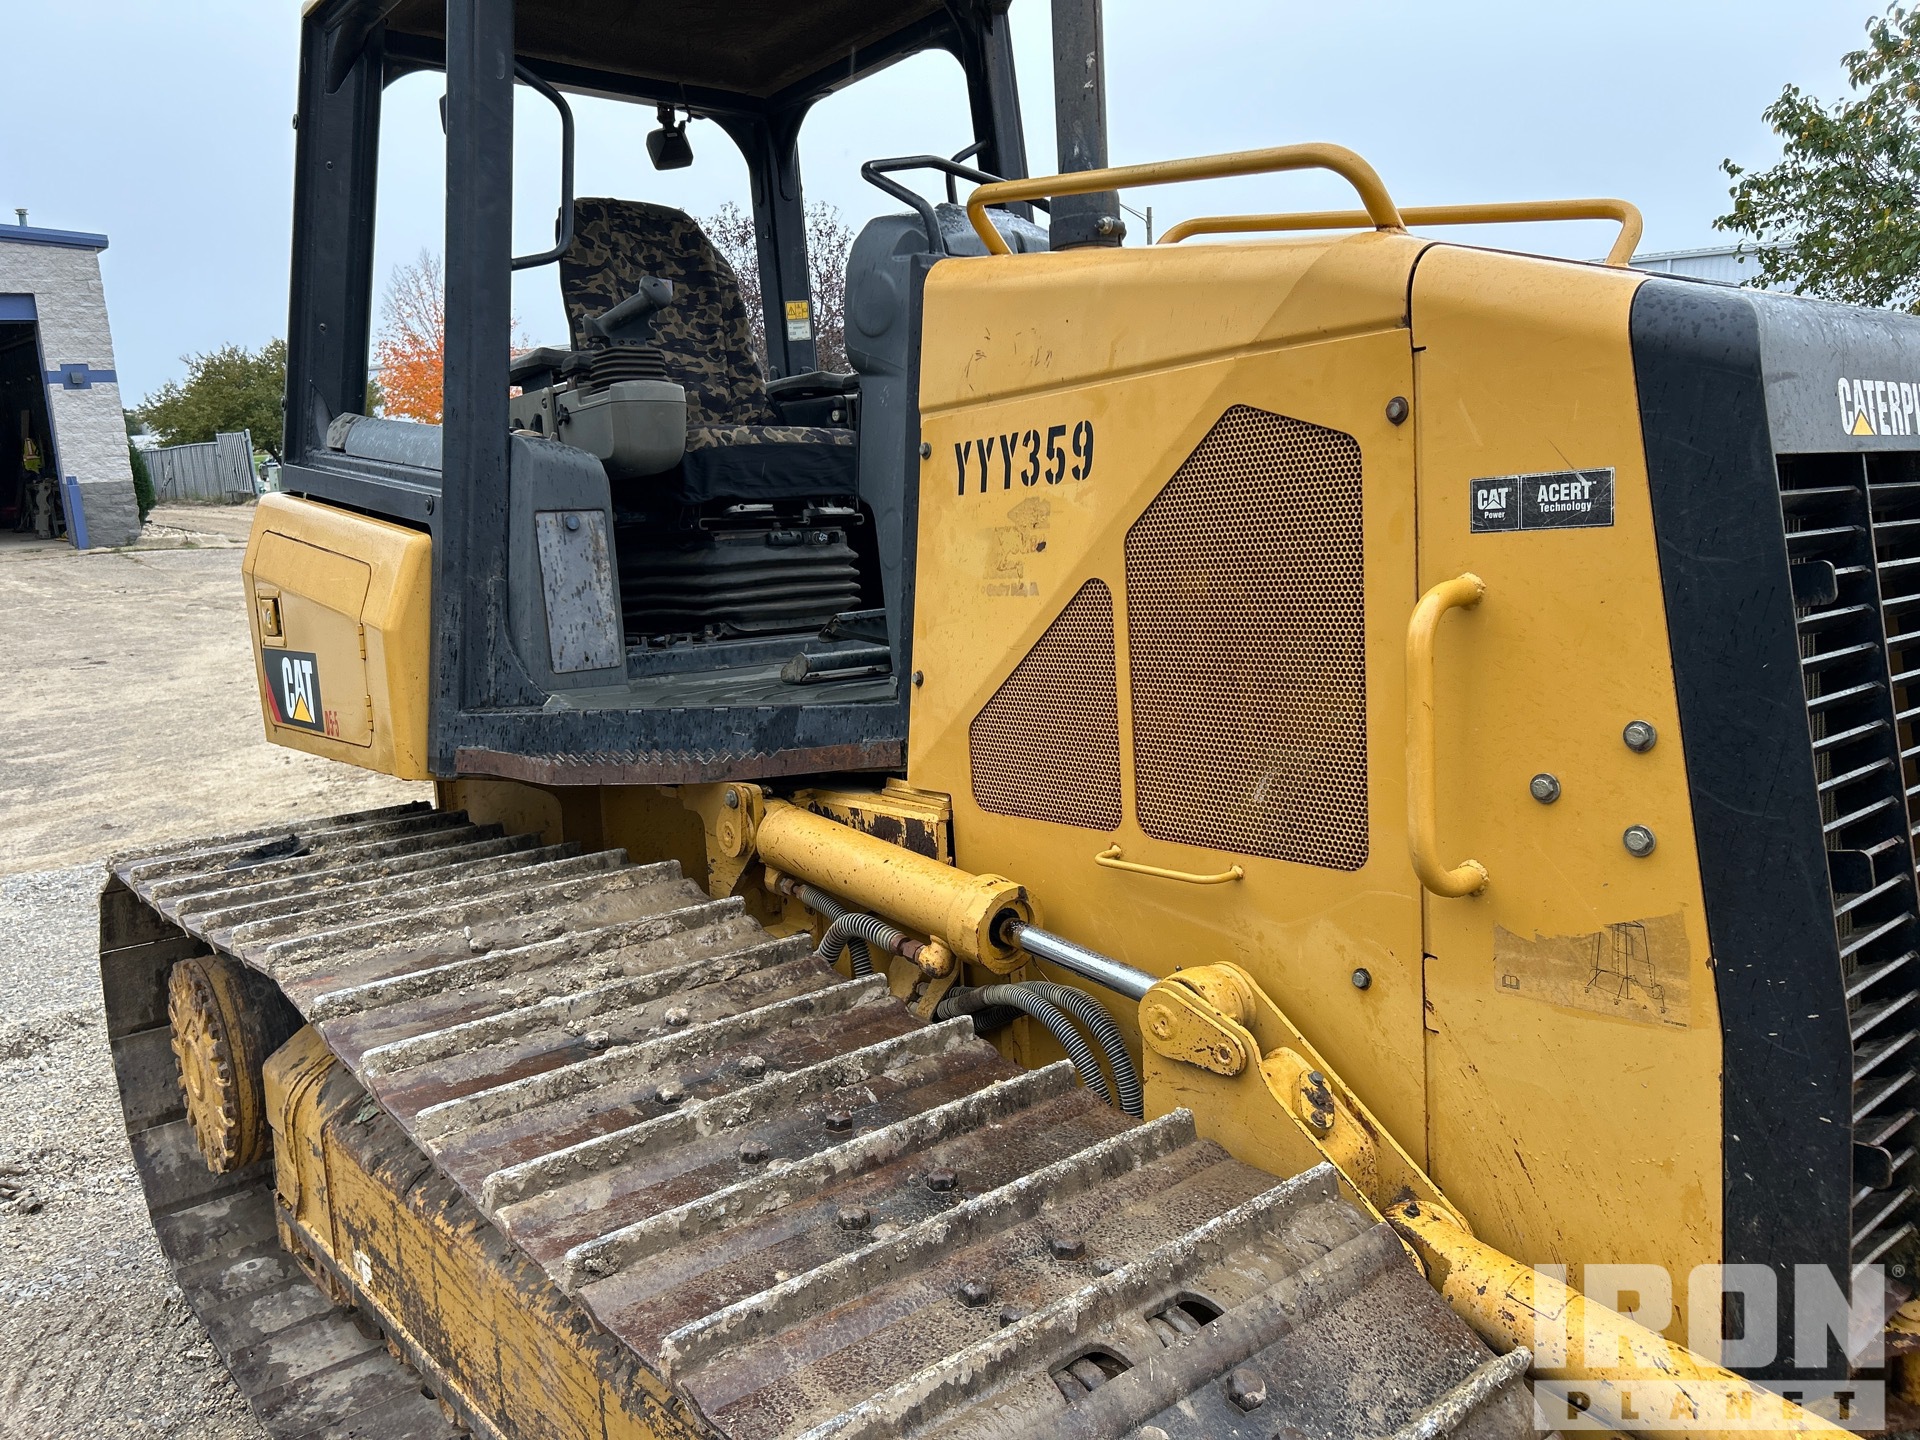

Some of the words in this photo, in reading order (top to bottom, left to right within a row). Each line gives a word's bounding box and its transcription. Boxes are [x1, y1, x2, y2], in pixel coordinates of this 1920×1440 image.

[1837, 377, 1920, 436] CATERPI
[954, 420, 1094, 496] YYY359
[1477, 487, 1509, 510] CAT
[1537, 481, 1592, 502] ACERT
[1484, 511, 1506, 520] Power
[1539, 501, 1592, 513] Technology
[281, 656, 316, 724] CAT
